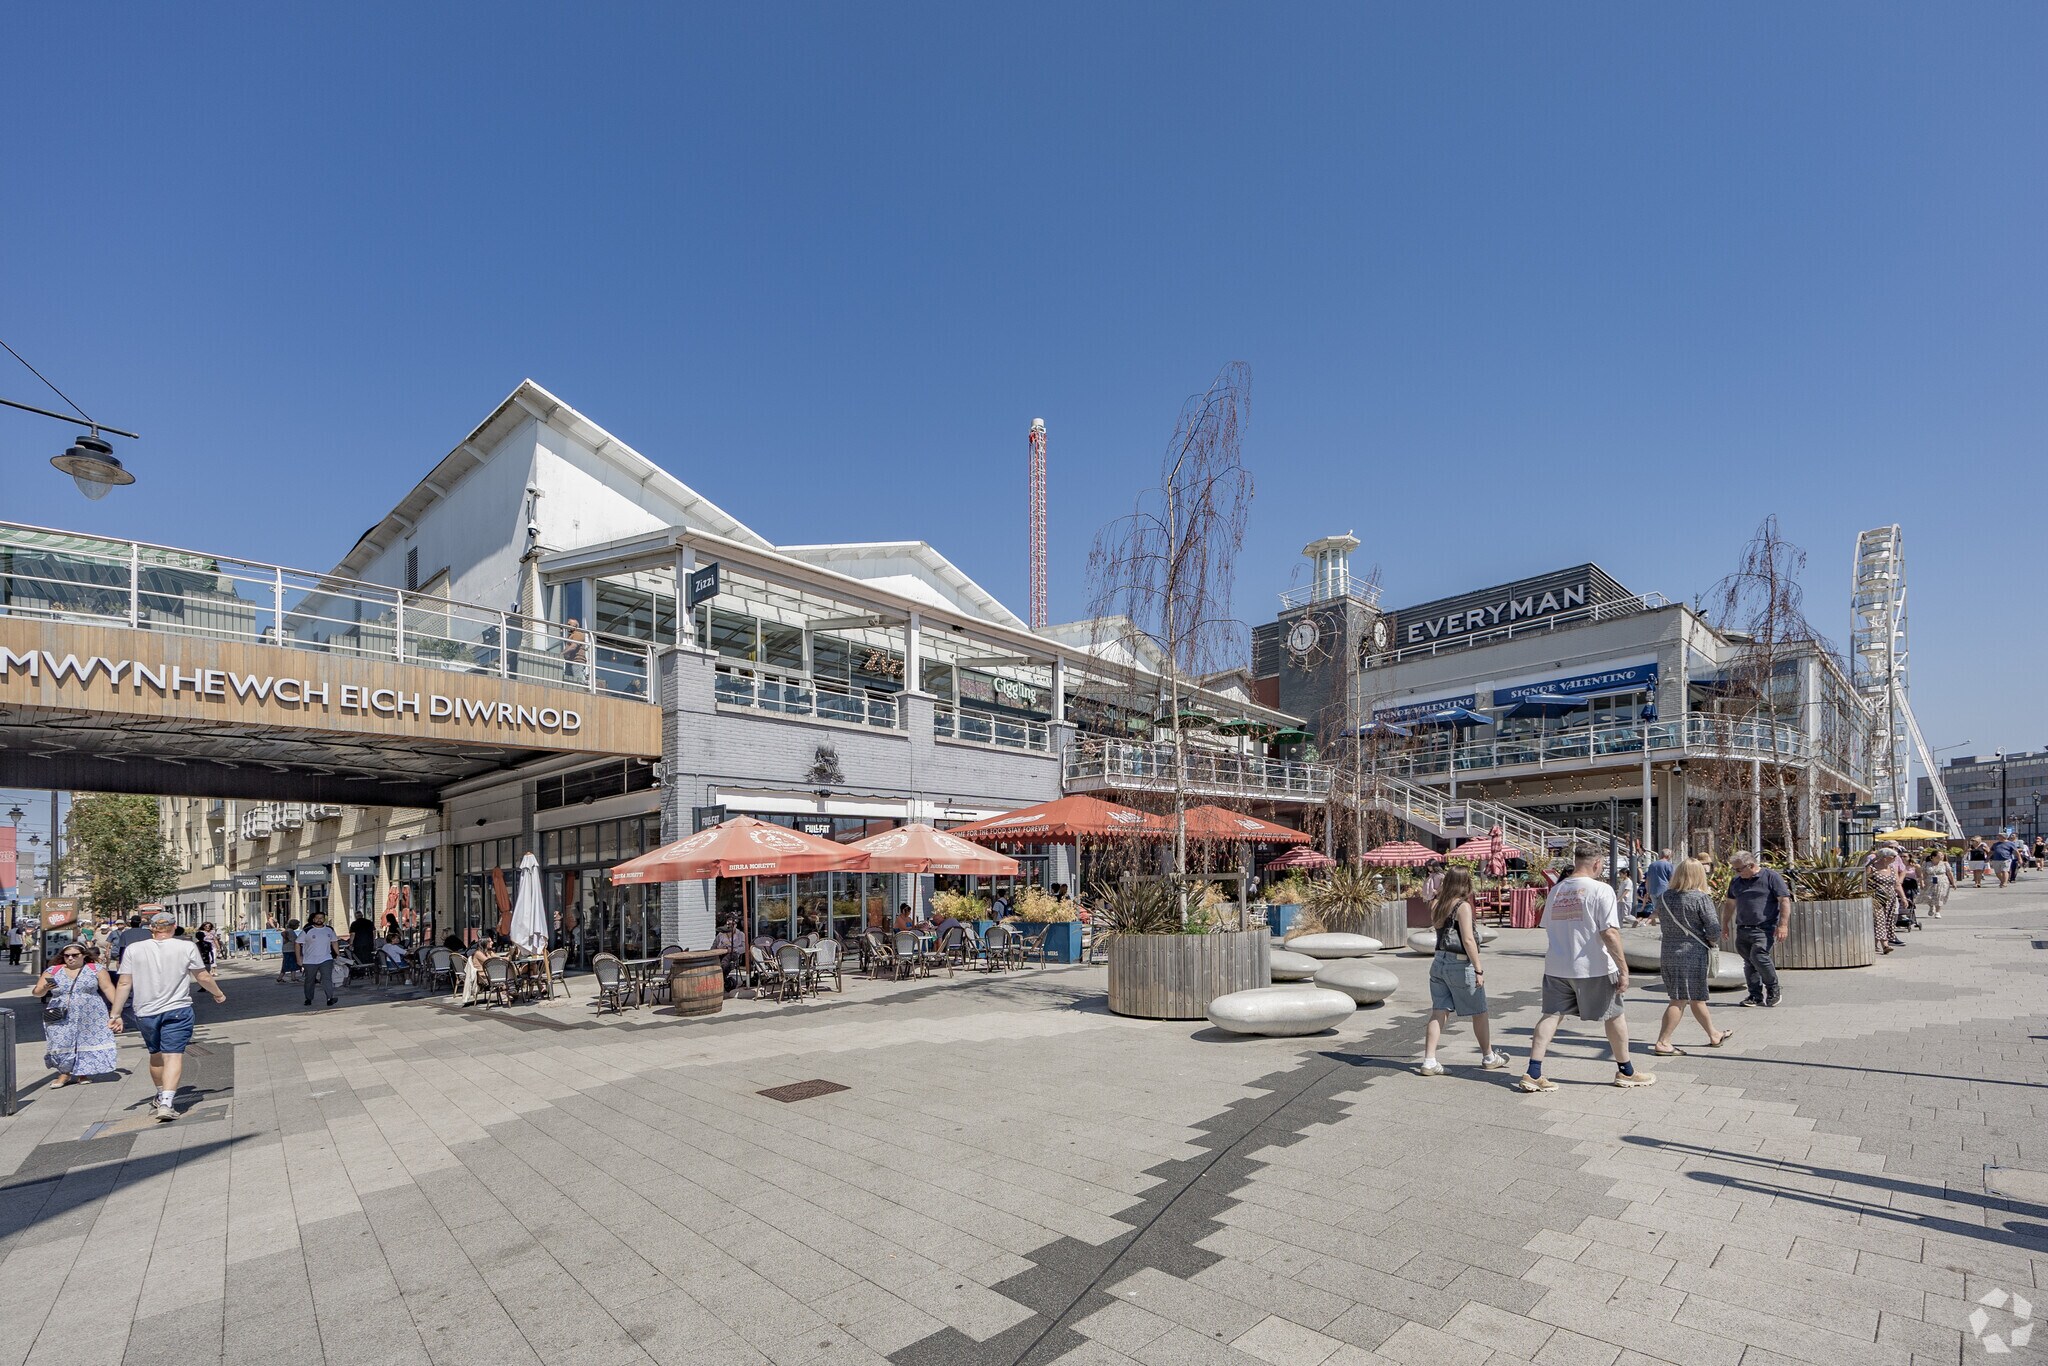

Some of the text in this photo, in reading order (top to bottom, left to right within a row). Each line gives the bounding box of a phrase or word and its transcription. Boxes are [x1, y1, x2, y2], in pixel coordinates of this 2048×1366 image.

[695, 574, 715, 593] Zizzi
[1408, 584, 1585, 643] EVERYMAN
[0, 646, 582, 730] MWYNHEWCH EICH DIWRNOD
[993, 677, 1037, 704] Giggling
[1511, 670, 1637, 699] SIGNOR VALENTINO
[1374, 697, 1474, 721] SIGNOR VALENTINO
[1023, 824, 1050, 833] FOREVER
[750, 862, 776, 870] MORETTI
